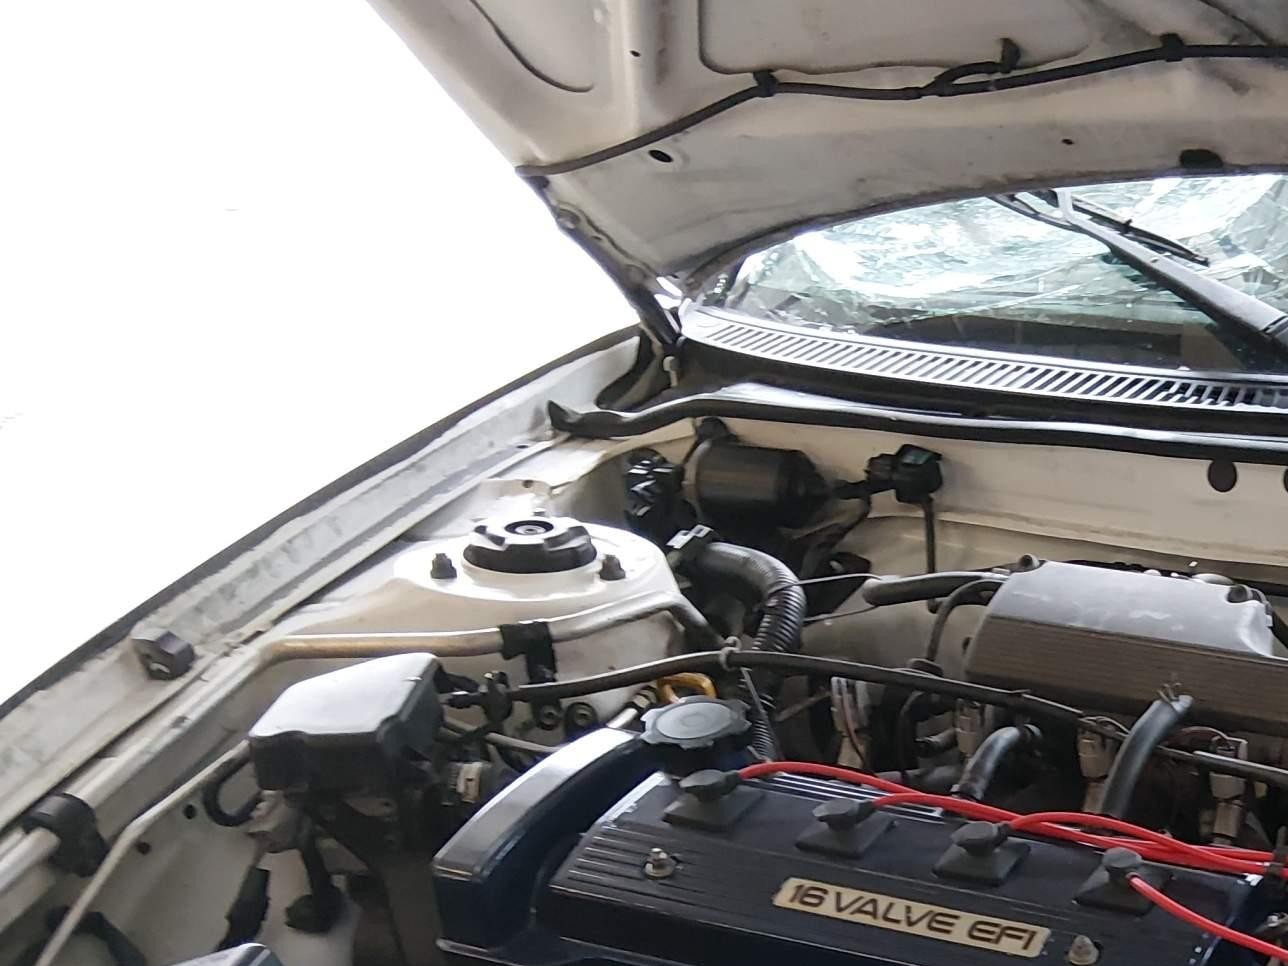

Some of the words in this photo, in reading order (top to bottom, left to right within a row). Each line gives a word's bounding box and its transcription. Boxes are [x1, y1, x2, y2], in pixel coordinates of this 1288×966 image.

[788, 884, 829, 908] 16
[834, 891, 961, 934] VALVE
[967, 919, 1037, 950] EFI
